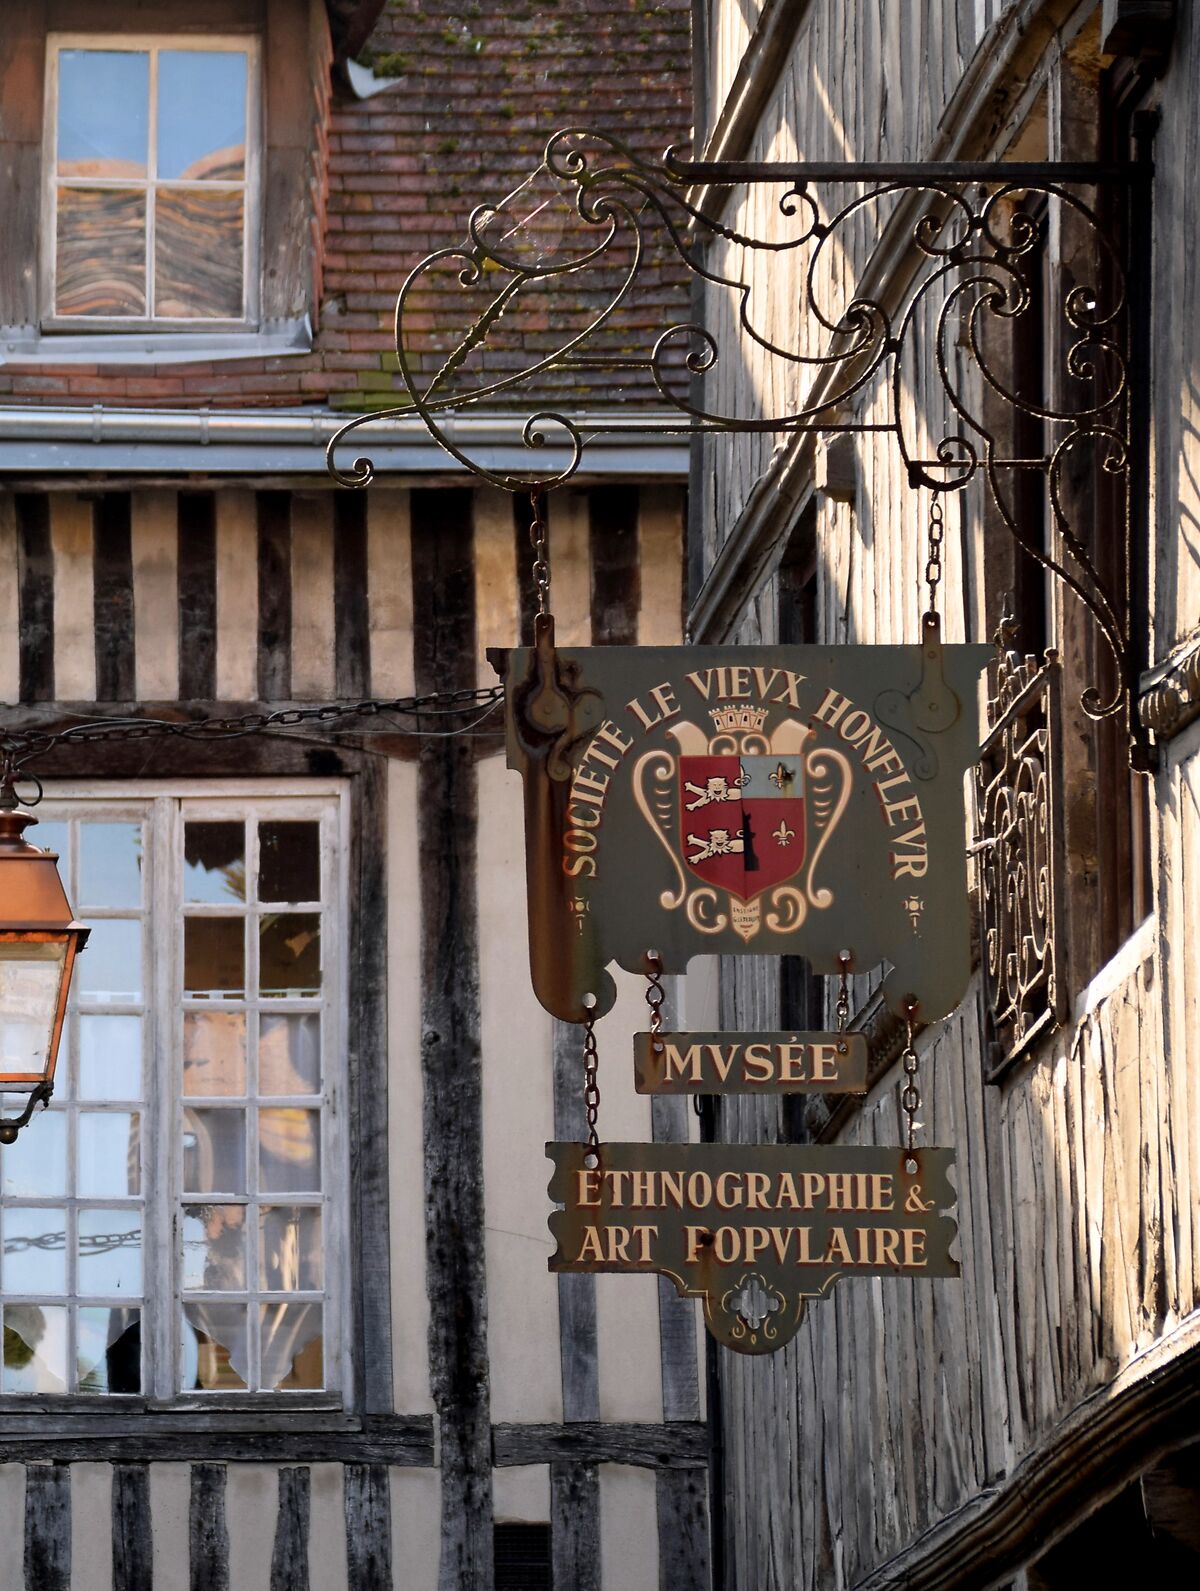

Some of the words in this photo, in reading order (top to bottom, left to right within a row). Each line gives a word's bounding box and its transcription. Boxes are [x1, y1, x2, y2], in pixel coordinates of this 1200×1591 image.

[625, 681, 681, 732] LE
[684, 666, 809, 710] VIEVX
[812, 687, 929, 881] HONFLEVR
[663, 1035, 840, 1083] MVSÉE
[576, 1169, 895, 1212] ETHNOGRAPHIE
[904, 1184, 936, 1213] &
[576, 1225, 658, 1264] ART
[685, 1225, 929, 1267] POPVLAIRE
